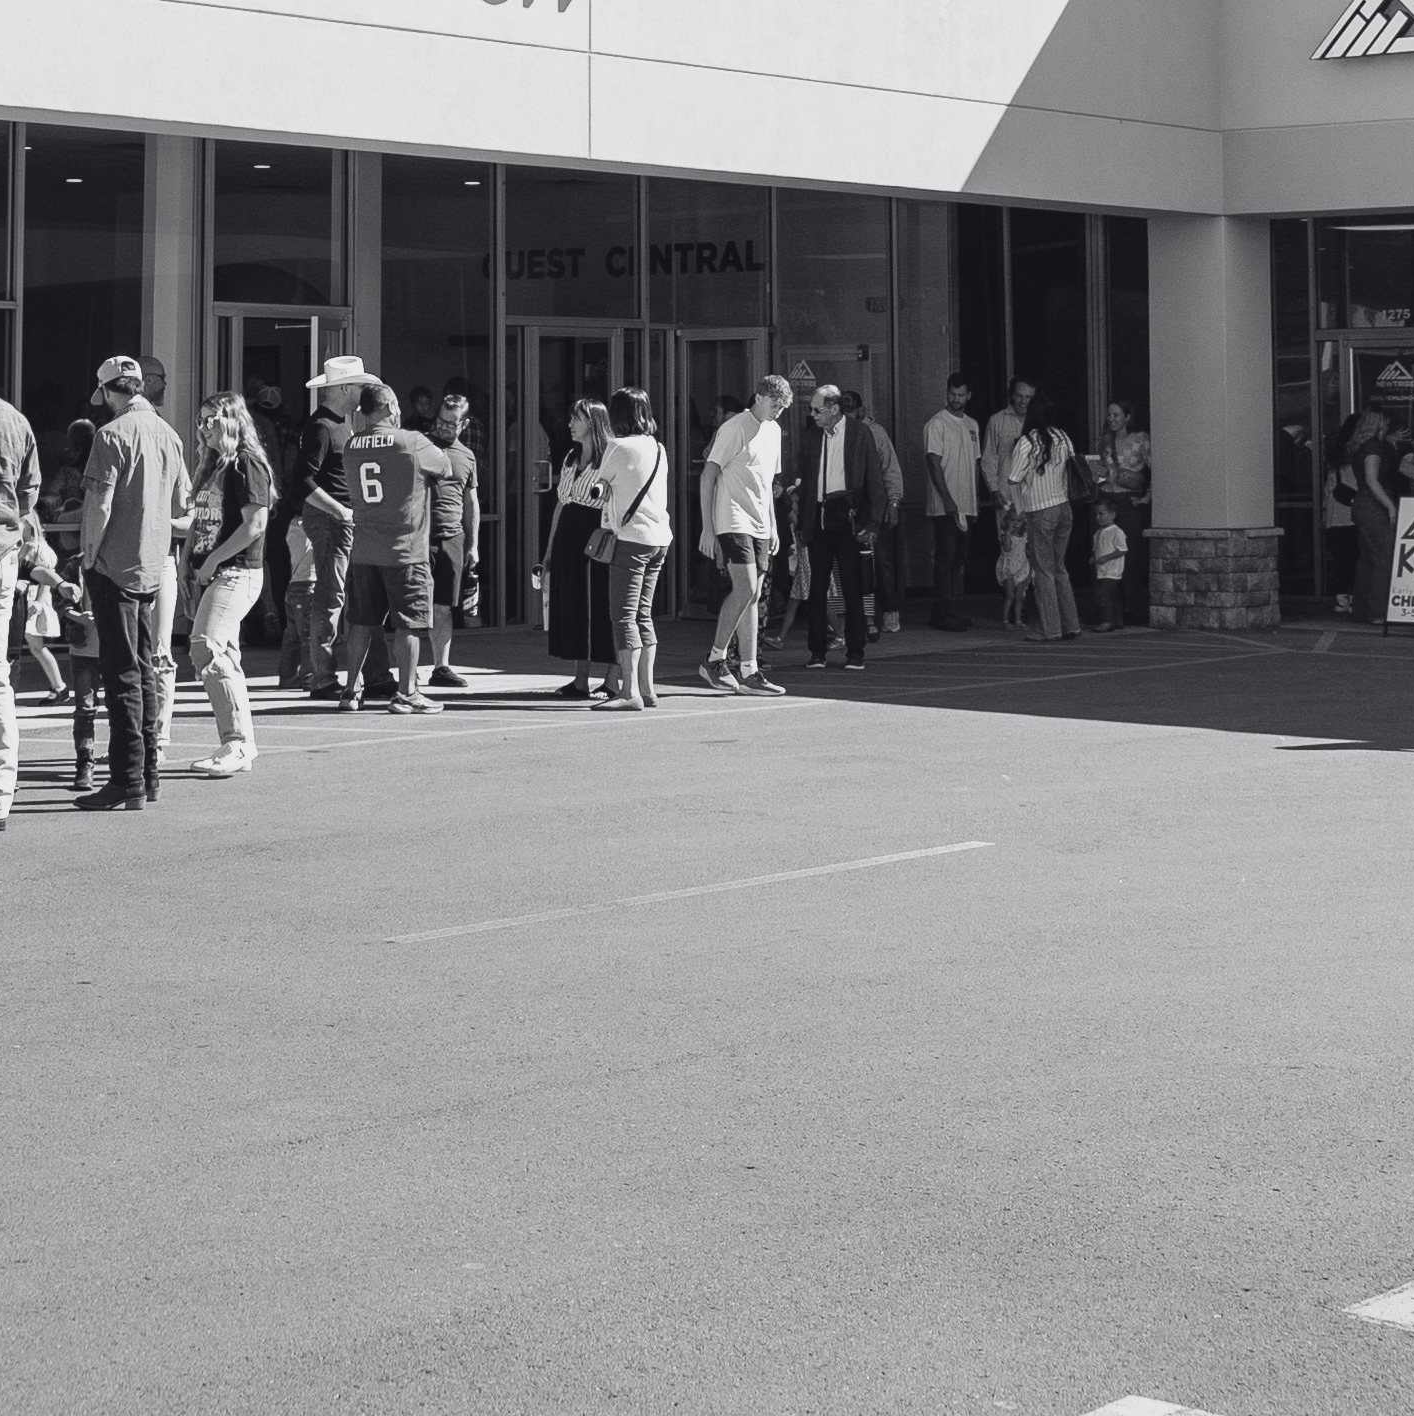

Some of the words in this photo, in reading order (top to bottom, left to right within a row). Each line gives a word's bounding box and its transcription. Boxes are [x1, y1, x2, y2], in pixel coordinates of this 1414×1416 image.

[1382, 308, 1411, 320] 1275
[350, 434, 395, 449] MAYFIELD
[359, 461, 384, 504] 6
